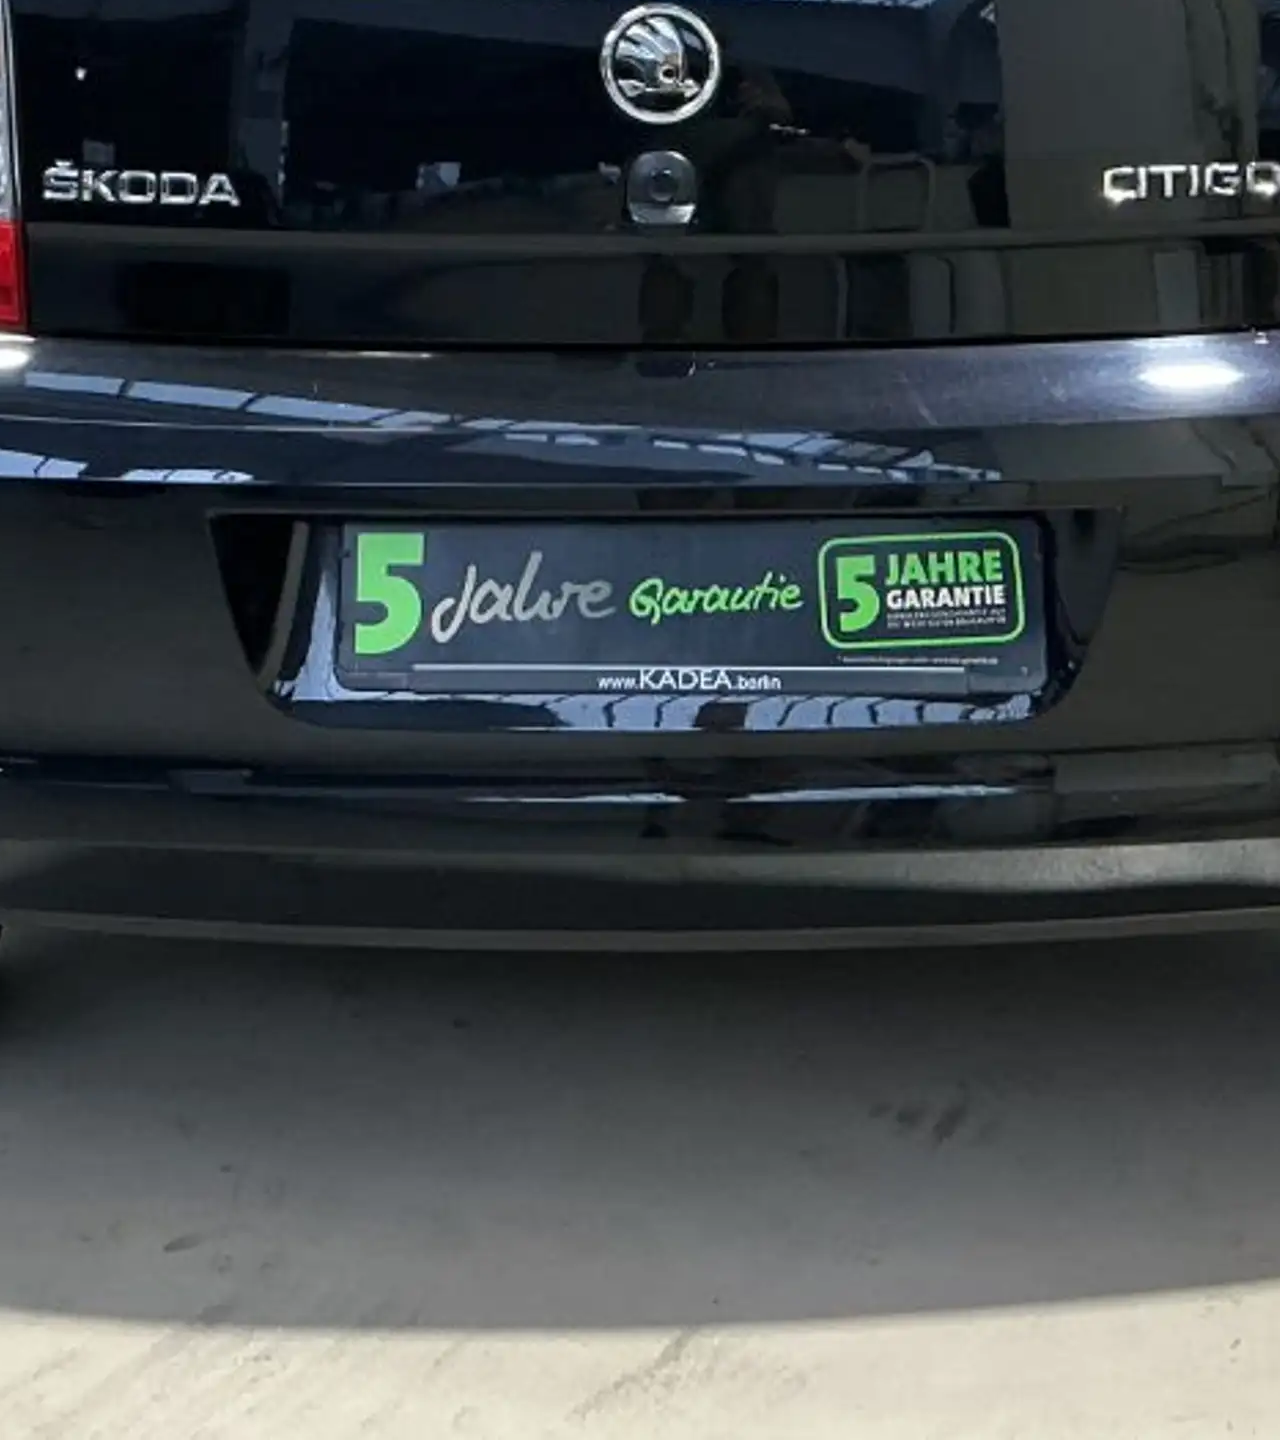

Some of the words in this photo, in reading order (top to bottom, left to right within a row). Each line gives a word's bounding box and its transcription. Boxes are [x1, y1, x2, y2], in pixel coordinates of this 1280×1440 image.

[42, 160, 241, 208] ŠKODA
[354, 532, 425, 655] 5
[430, 550, 617, 644] Jahre
[629, 570, 806, 627] Garantie
[835, 554, 881, 633] 5
[884, 549, 1004, 587] JAHRE
[885, 585, 1007, 611] GARANTIE
[598, 668, 782, 691] www.KADEA.berlin
